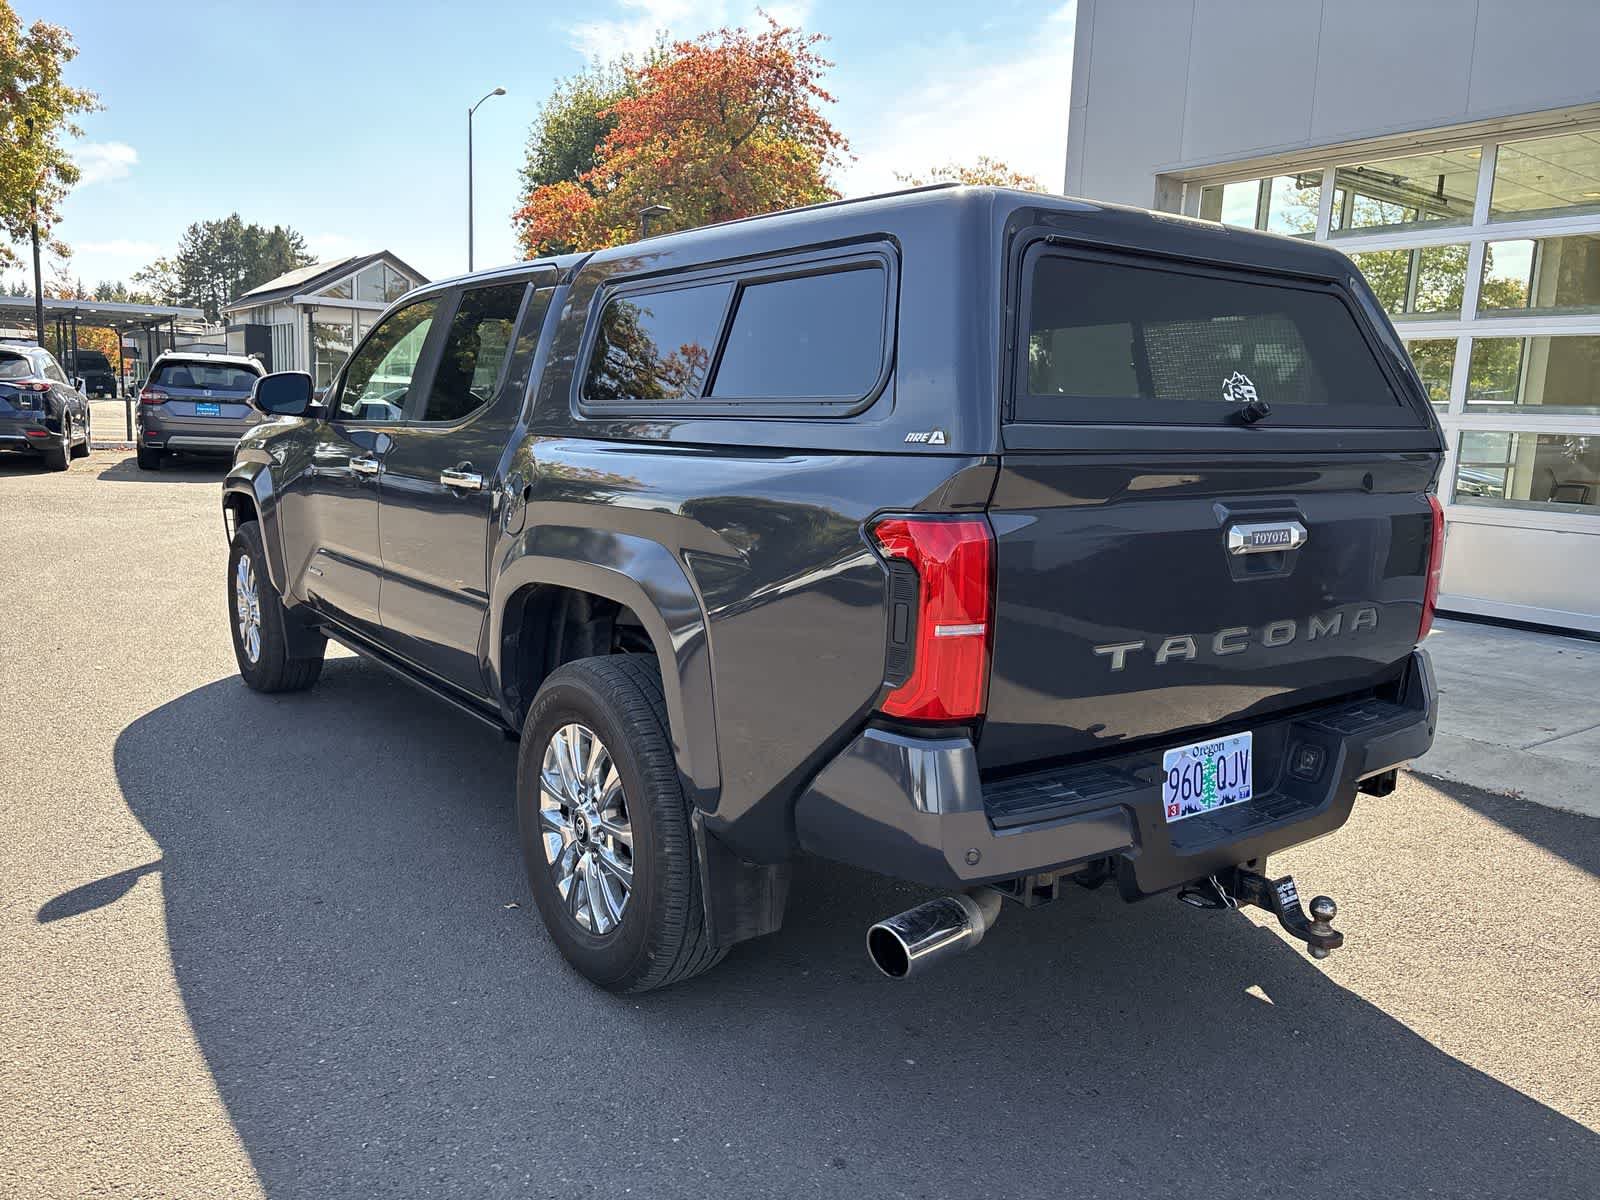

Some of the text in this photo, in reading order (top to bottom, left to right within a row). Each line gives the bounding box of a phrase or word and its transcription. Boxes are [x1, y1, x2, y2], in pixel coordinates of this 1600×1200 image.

[1254, 531, 1290, 544] TOYOTA
[1094, 606, 1378, 671] TACOMA
[1192, 742, 1225, 758] Oregon
[1169, 749, 1249, 804] 960 QJV
